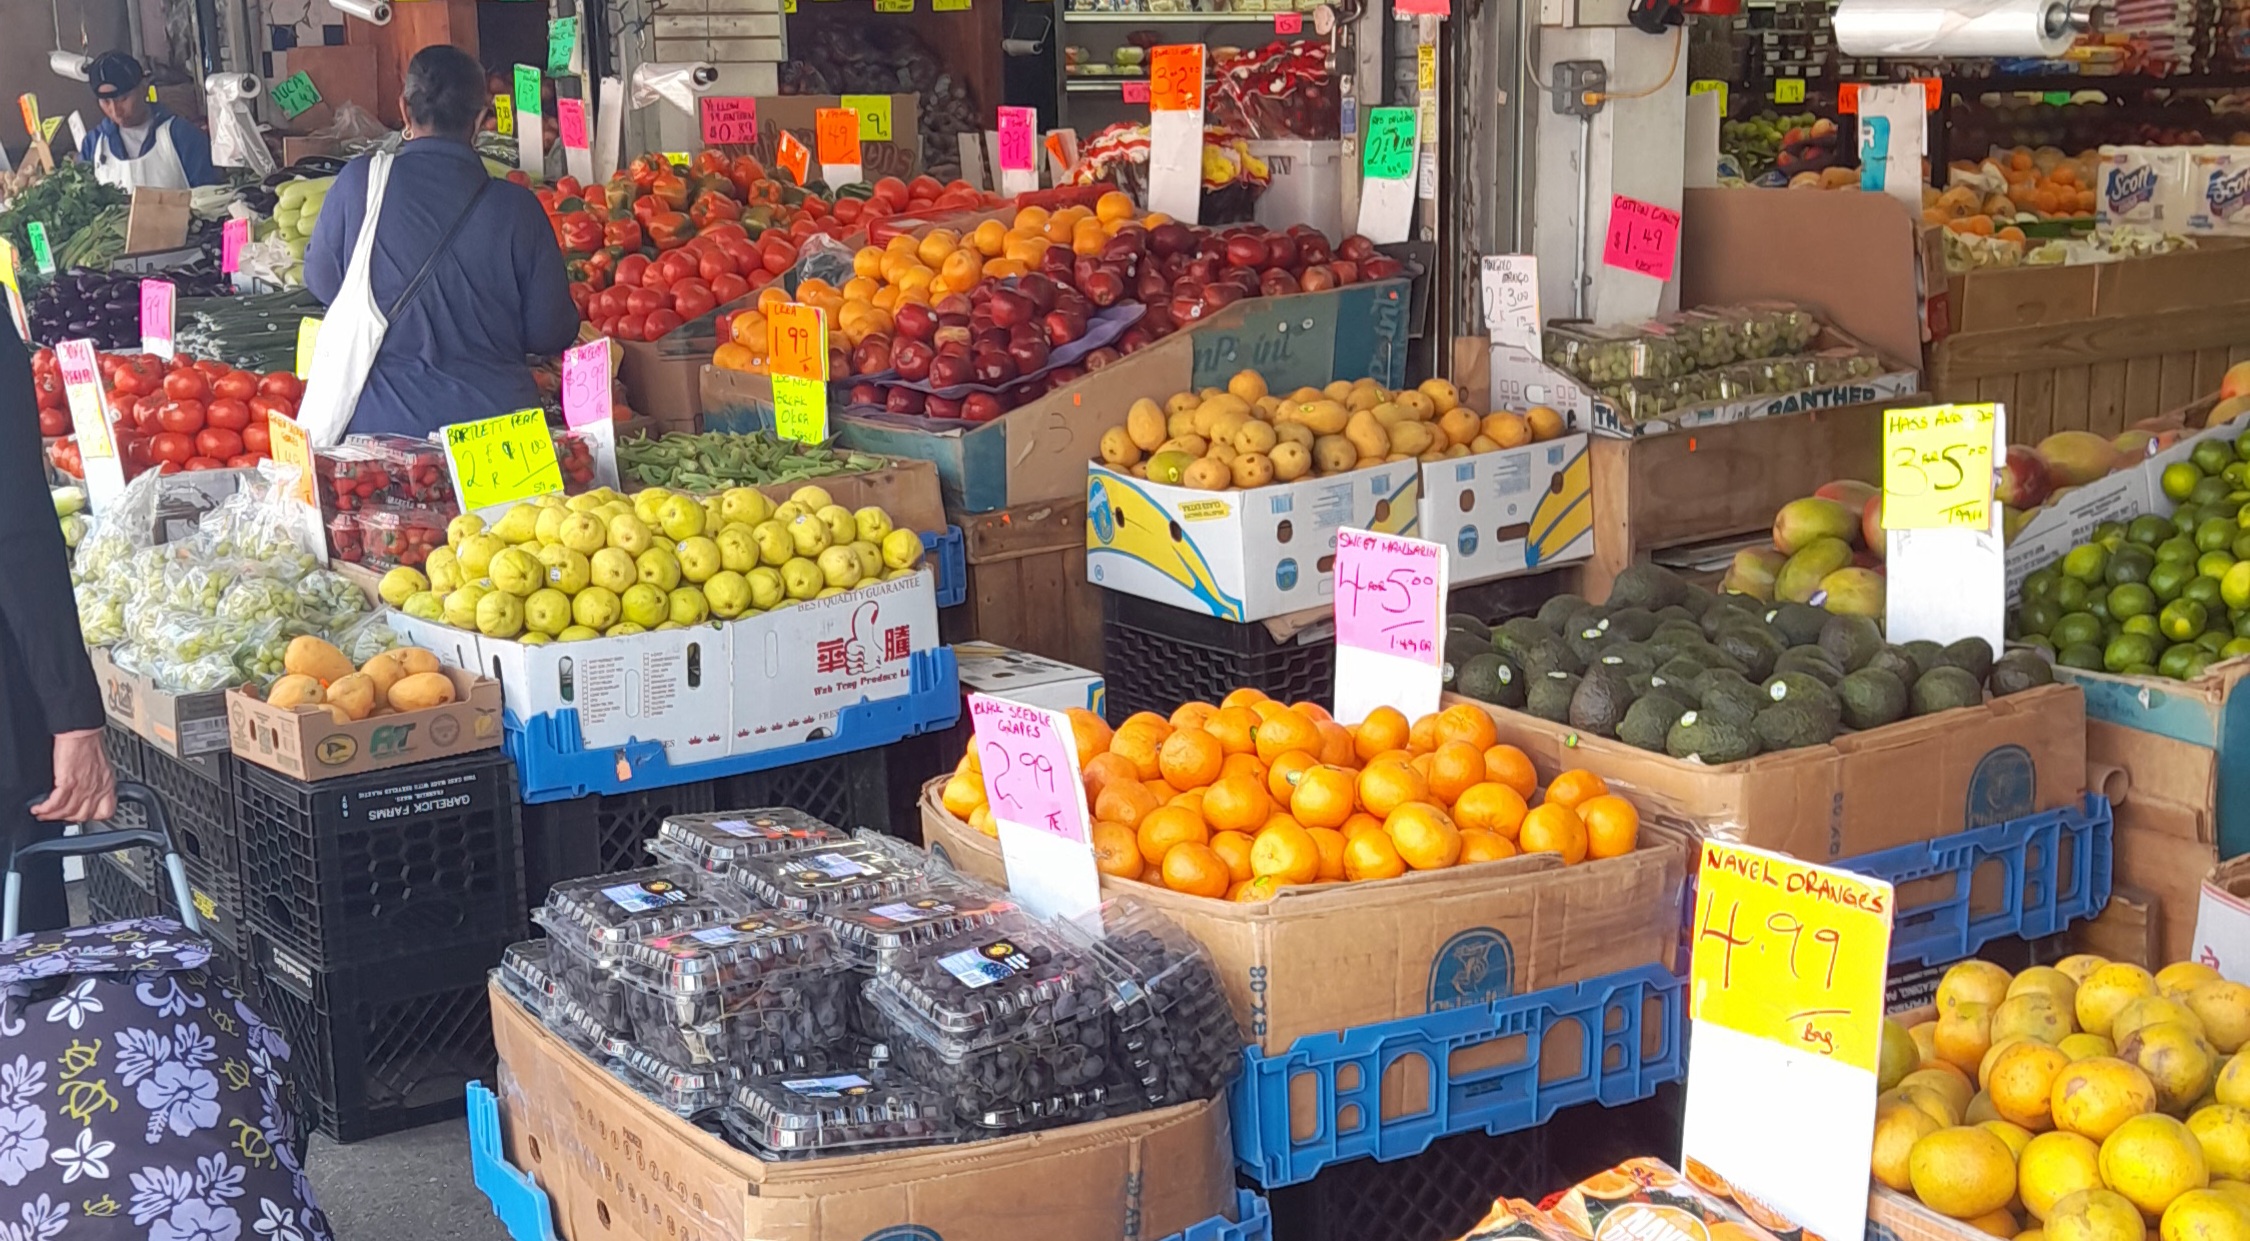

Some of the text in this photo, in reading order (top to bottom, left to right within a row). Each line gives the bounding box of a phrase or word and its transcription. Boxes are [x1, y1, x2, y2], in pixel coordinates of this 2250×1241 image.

[1767, 386, 1876, 417] PANTHER
[446, 417, 506, 448] BARTLETT
[1595, 402, 1629, 434] TH
[1890, 416, 1928, 434] HASS
[462, 450, 484, 489] 2
[1339, 532, 1438, 558] SWEET MANDARIN
[866, 577, 921, 598] GUARANTEE
[1339, 561, 1366, 617] 4
[860, 671, 898, 685] Produce
[998, 720, 1041, 738] GRAPES
[368, 794, 471, 822] GARELICK FARMS
[1707, 848, 1884, 914] NAVEL ORANGES
[1700, 891, 1840, 990] 4.99
